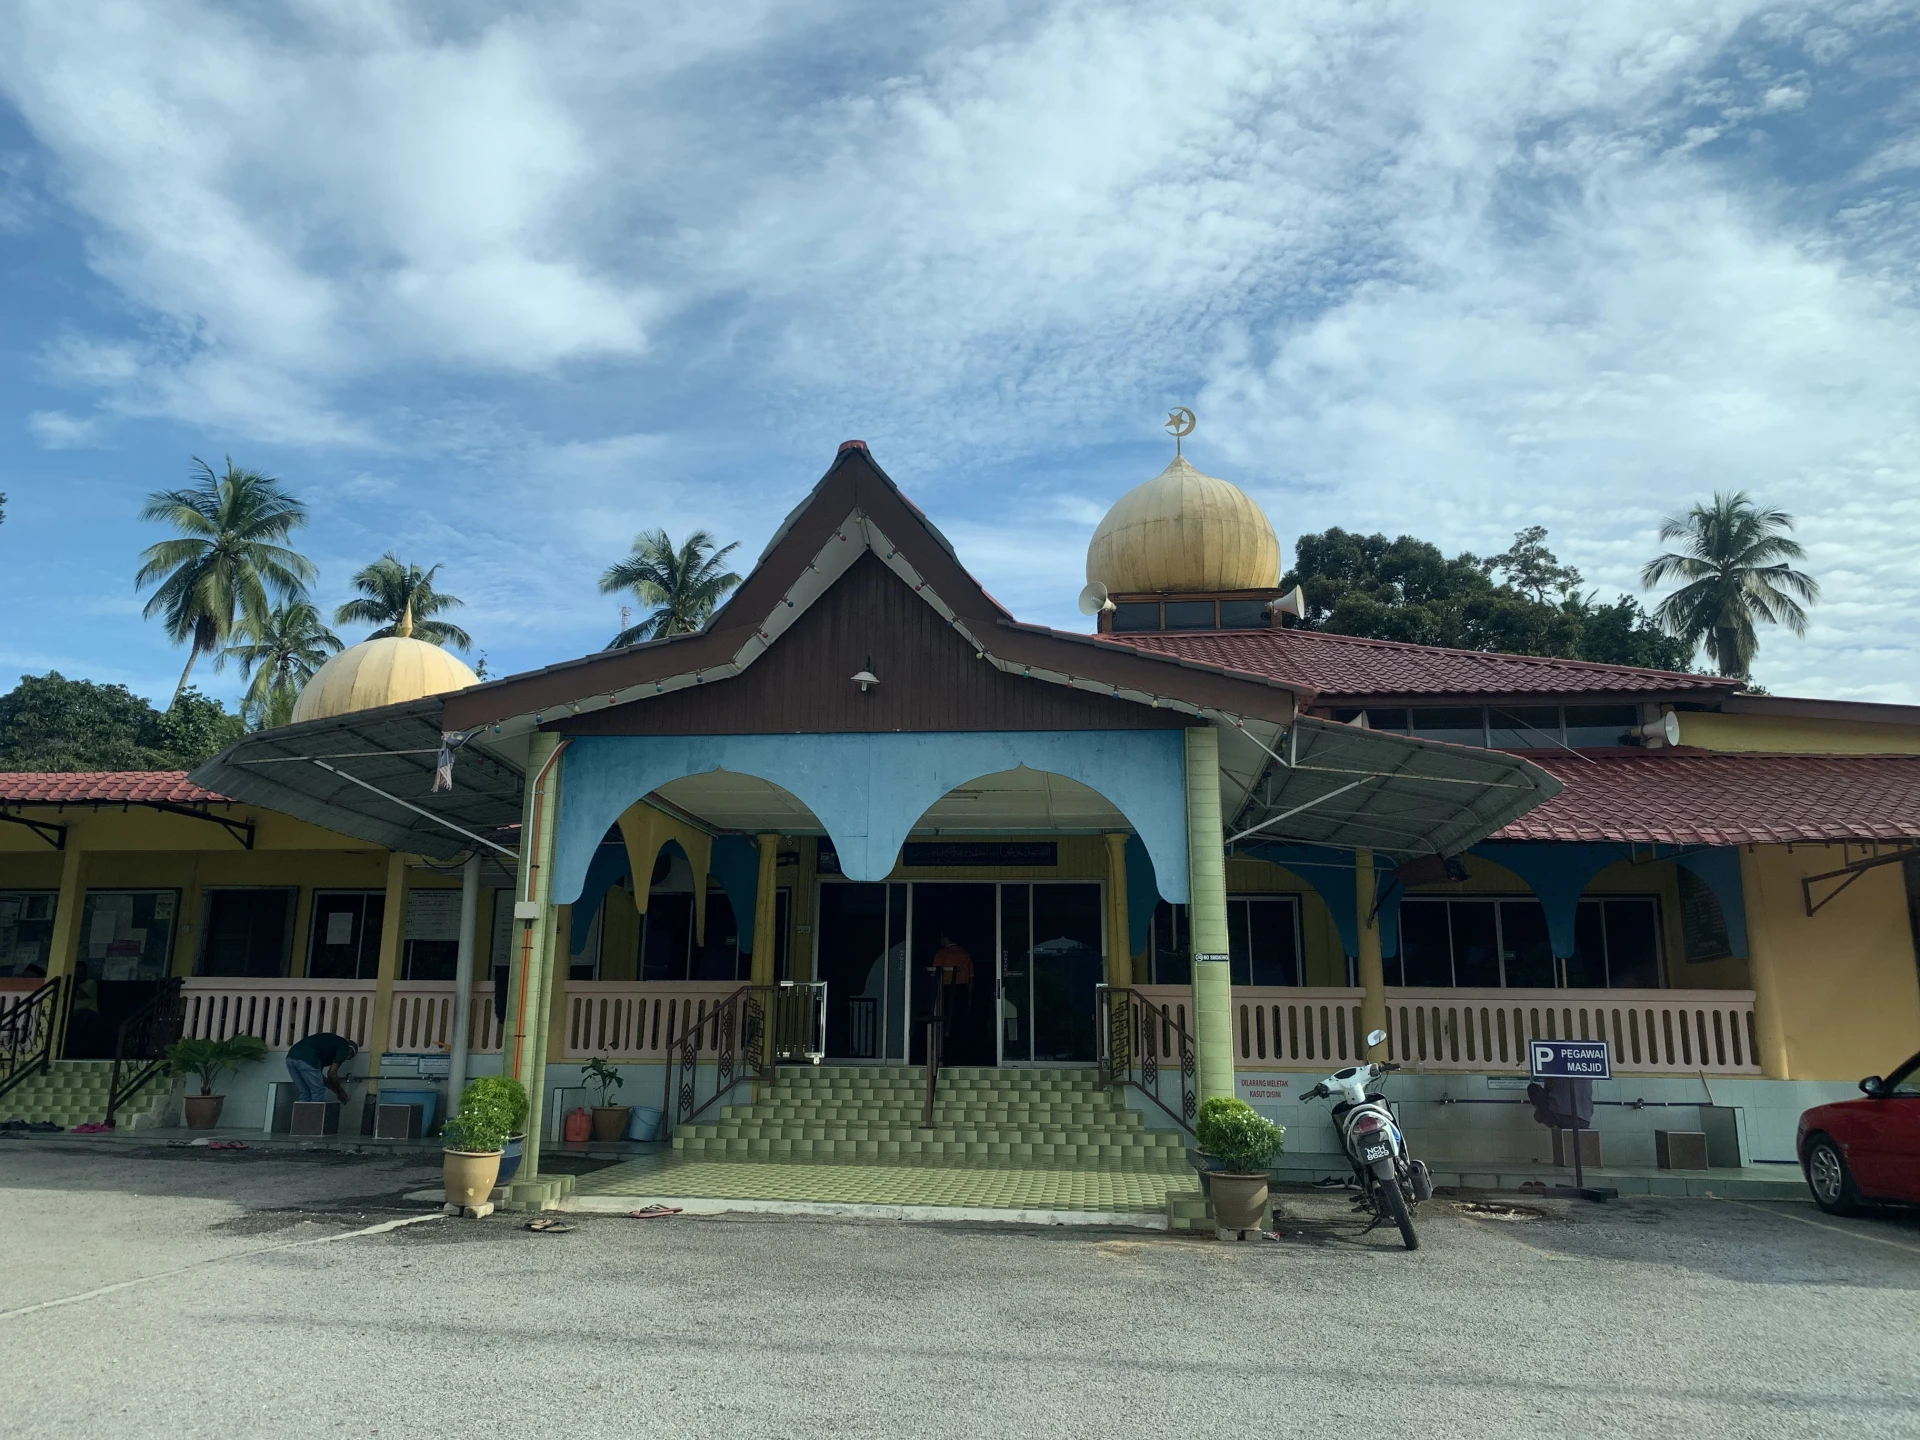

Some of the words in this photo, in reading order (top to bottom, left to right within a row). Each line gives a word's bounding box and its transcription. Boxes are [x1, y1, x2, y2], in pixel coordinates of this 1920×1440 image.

[1535, 1046, 1554, 1070] P
[1561, 1049, 1604, 1058] PEGAWAI
[1567, 1062, 1602, 1072] MASJID
[1241, 1079, 1266, 1087] DILARANG
[1250, 1090, 1265, 1098] KASUT
[1367, 1145, 1385, 1154] NCH
[1367, 1150, 1389, 1160] 8629
